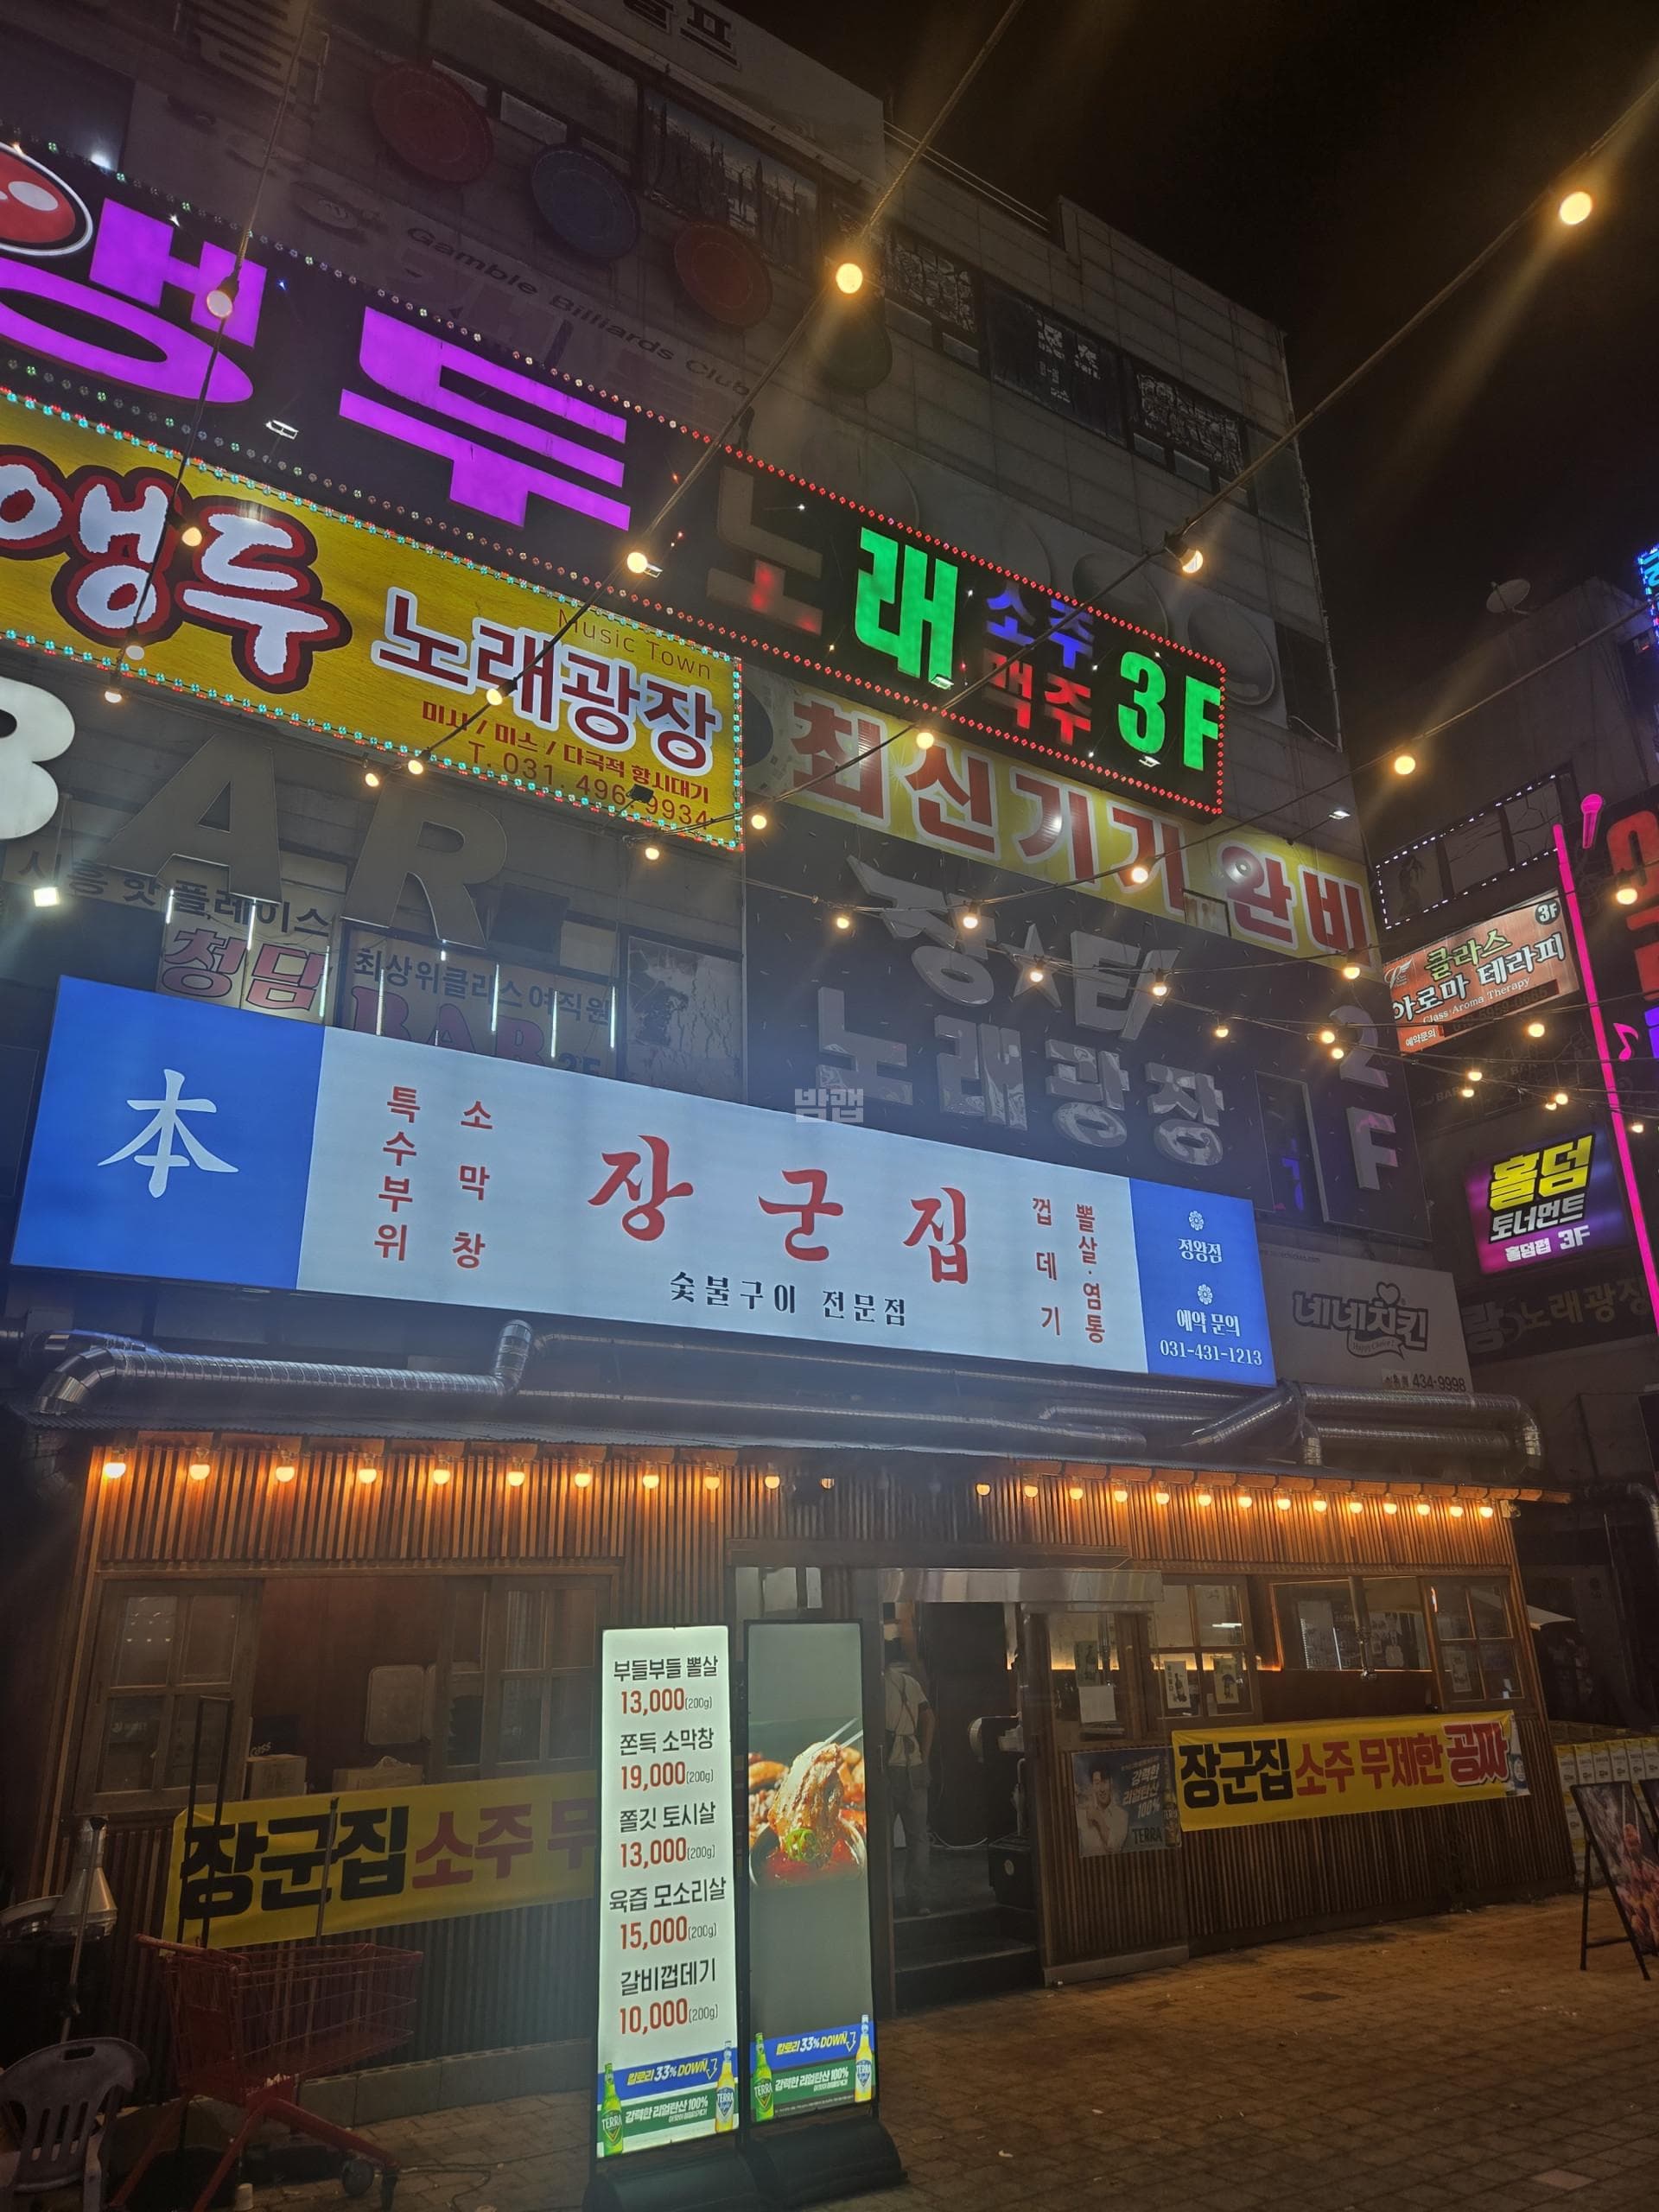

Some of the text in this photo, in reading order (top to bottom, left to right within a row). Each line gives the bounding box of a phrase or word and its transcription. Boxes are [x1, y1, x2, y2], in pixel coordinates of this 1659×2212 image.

[407, 226, 750, 396] Gamble Billiards Club
[558, 608, 711, 680] Music Town
[985, 581, 1095, 671] 소주
[373, 589, 720, 773] 노래광장
[1119, 651, 1221, 771] 3F
[563, 744, 626, 779] 다국적
[631, 764, 709, 804] 항시대기
[789, 696, 1366, 959] 최신기기 완비
[161, 928, 326, 1011] 청담
[1392, 931, 1566, 1020] 아로마 테라피
[1425, 929, 1513, 982] 클라스
[1452, 996, 1484, 1014] Aroma
[1486, 976, 1530, 1001] Therapy
[817, 987, 1224, 1166] 노래광장
[97, 1069, 238, 1198] 本
[374, 1086, 421, 1262] 특수부위
[452, 1101, 493, 1269] 소막창
[1489, 1135, 1593, 1211] 홀덤
[1491, 1193, 1585, 1242] 토너먼트
[1558, 1225, 1591, 1249] 3F
[1178, 1238, 1224, 1264] 정왕점
[823, 1290, 906, 1327] 전문점
[1293, 1290, 1428, 1351] 네네치킨
[1160, 1339, 1263, 1366] 031-431-1213
[613, 1656, 719, 1682] 부들부들 뽈살
[620, 1688, 684, 1715] 13,000
[620, 1727, 715, 1757] 쫀득 소막창
[620, 1761, 686, 1791] 19,000
[1179, 1738, 1294, 1808] 장군집
[1296, 1740, 1356, 1796] 소주
[1360, 1732, 1445, 1789] 무제한
[620, 1802, 716, 1833] 쫄깃 토시살
[1132, 1827, 1163, 1845] TERRA
[180, 1805, 410, 1920] 장군집
[412, 1803, 534, 1889] 소주
[620, 1837, 687, 1868] 13,000
[609, 1877, 727, 1913] 육즙 모소리살
[620, 1916, 688, 1950] 15,000
[620, 1958, 716, 1996] 갈비껍데기
[620, 1998, 689, 2034] 10,000
[820, 2031, 848, 2047] DOWN
[677, 2058, 709, 2077] DOWN
[688, 2094, 709, 2110] 100%
